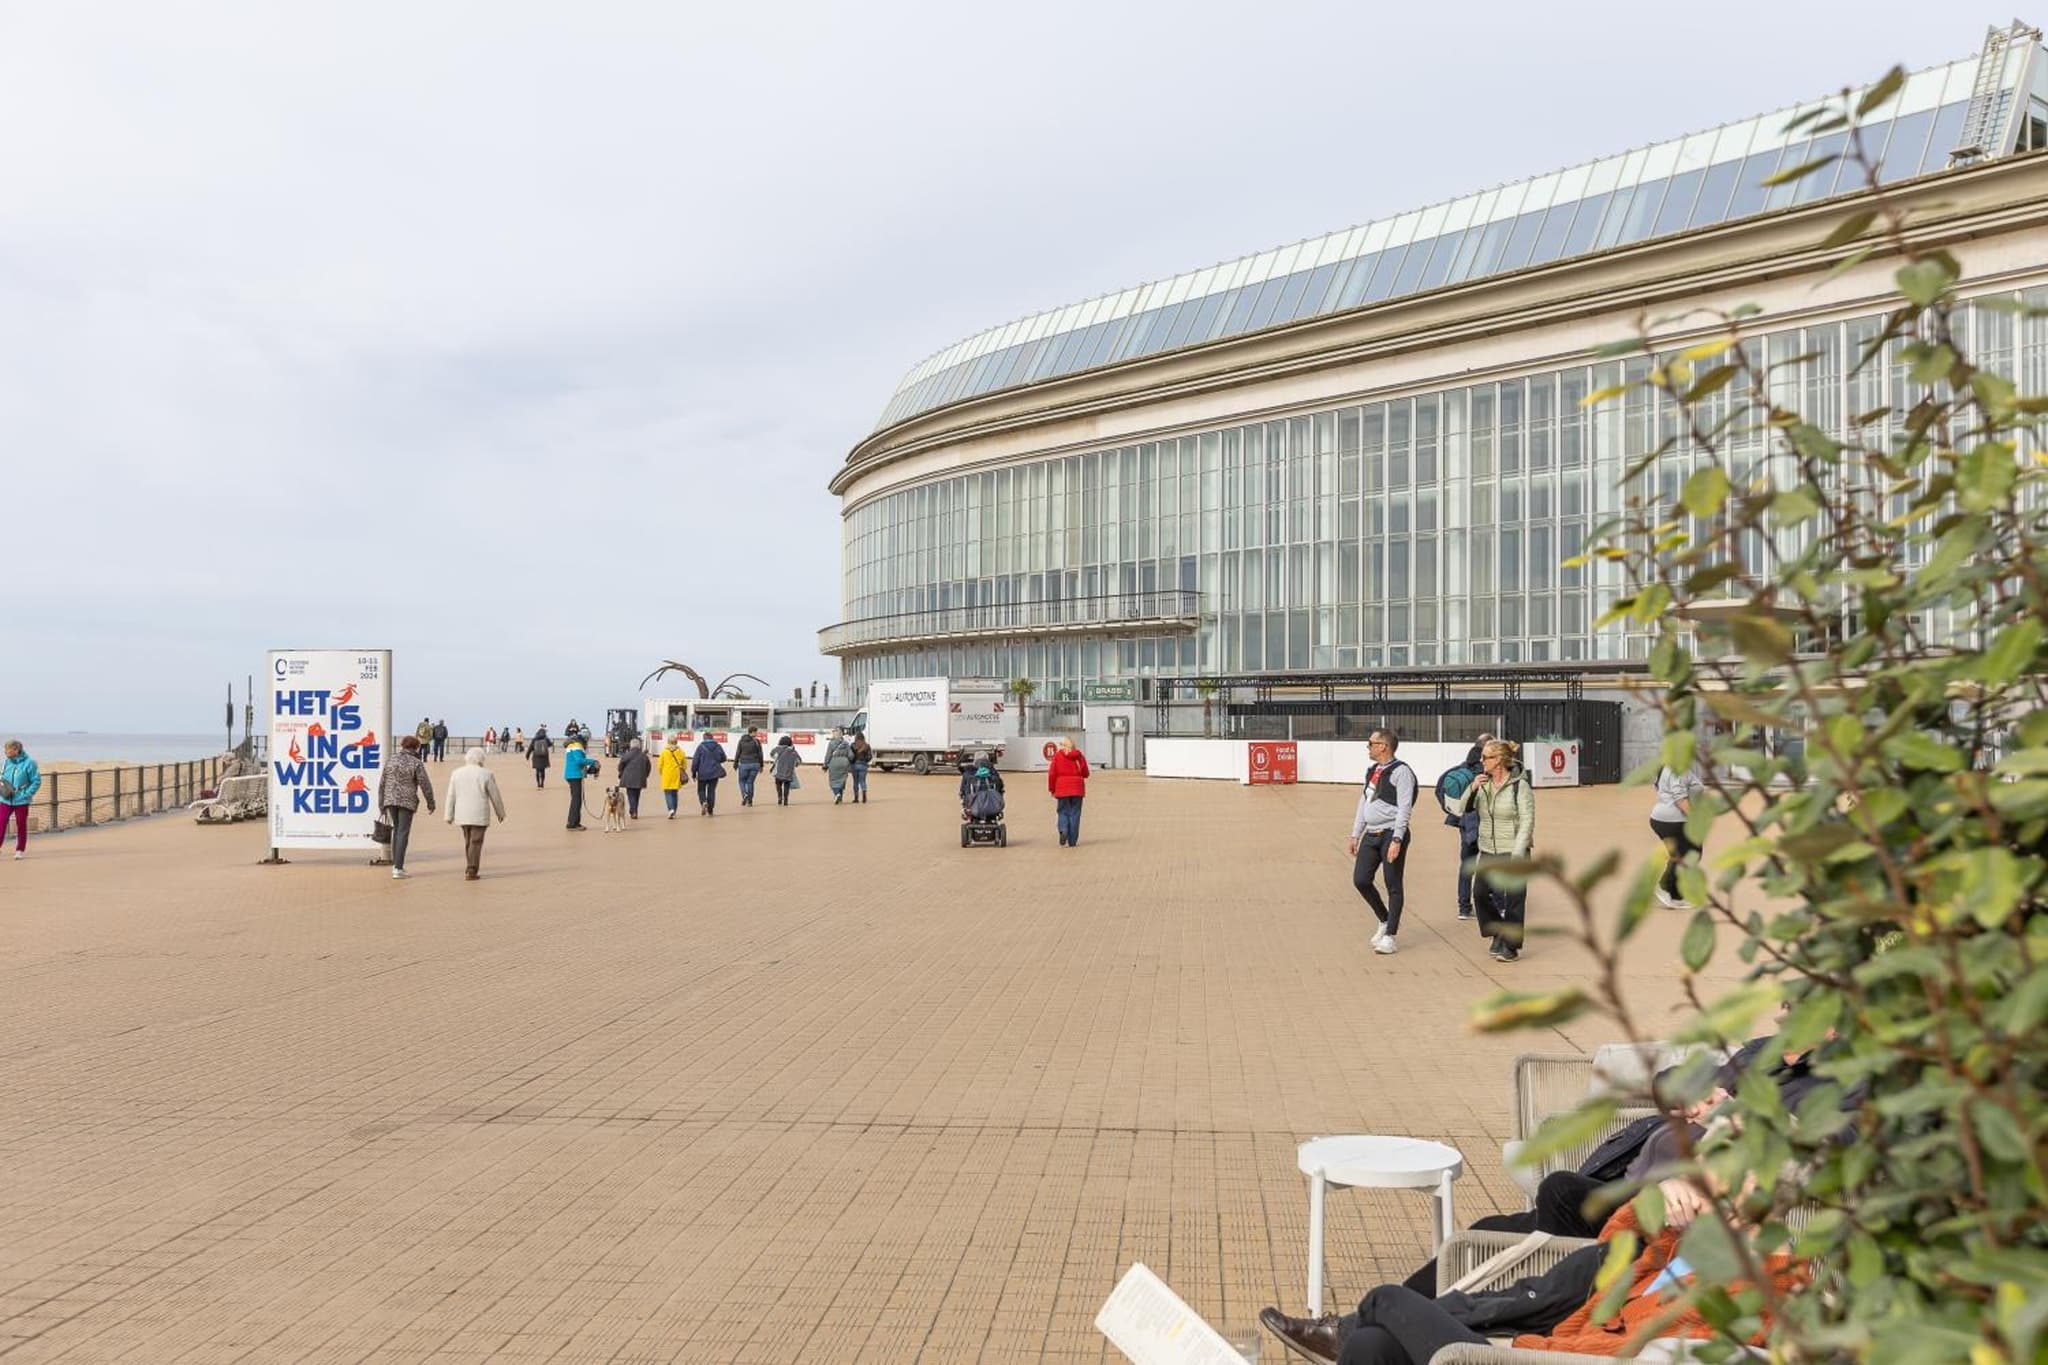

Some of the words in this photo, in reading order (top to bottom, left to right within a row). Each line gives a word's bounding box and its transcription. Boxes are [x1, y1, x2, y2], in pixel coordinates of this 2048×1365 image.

[358, 657, 378, 665] 10-11
[360, 672, 378, 680] 2024
[275, 690, 331, 715] HET
[895, 691, 937, 702] AUTOMOTIVE
[331, 705, 362, 731] IS
[307, 733, 338, 759] IN
[340, 744, 380, 769] GE
[274, 761, 338, 786] WIK
[293, 788, 369, 814] KELD
